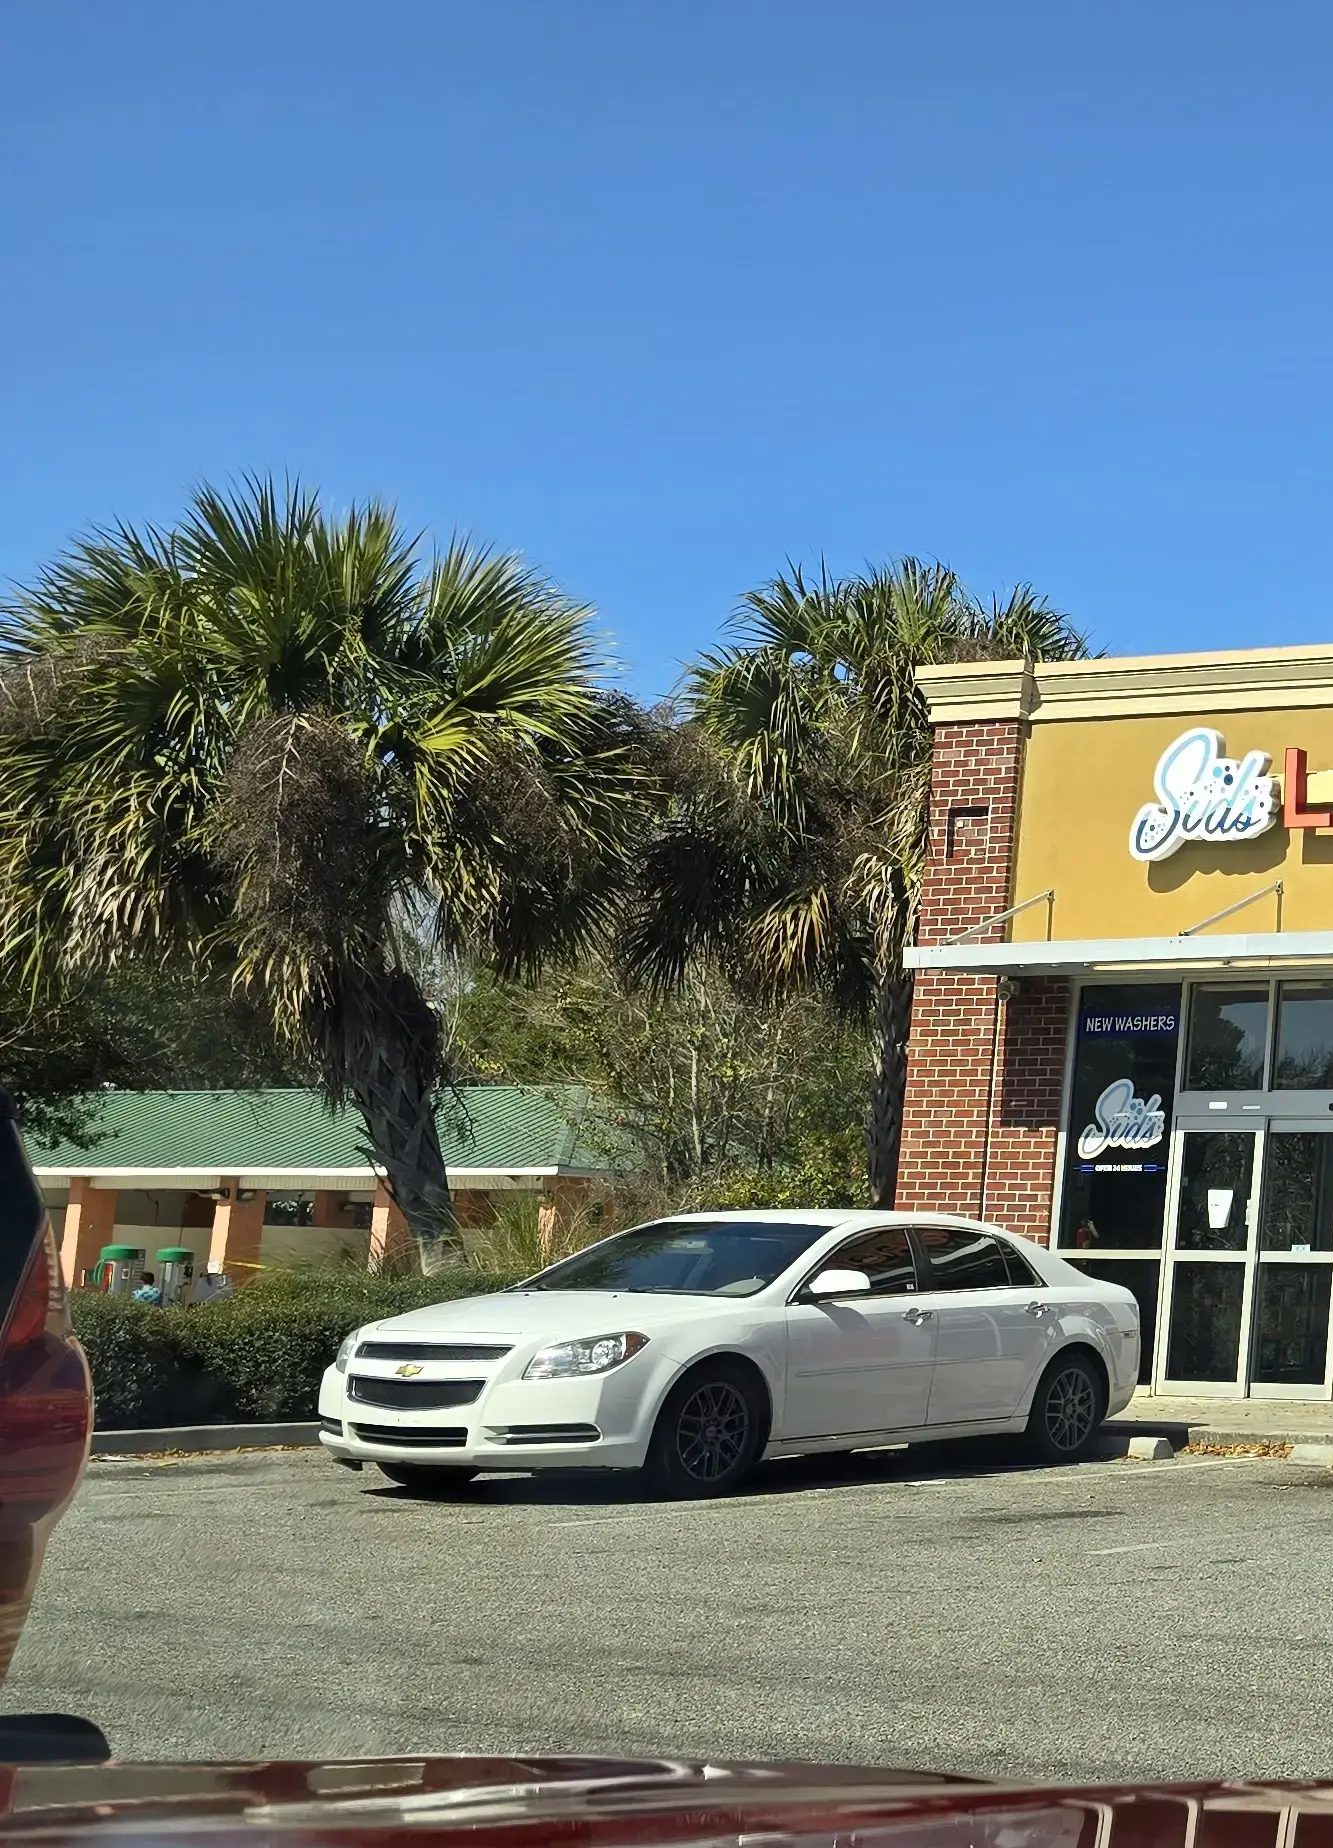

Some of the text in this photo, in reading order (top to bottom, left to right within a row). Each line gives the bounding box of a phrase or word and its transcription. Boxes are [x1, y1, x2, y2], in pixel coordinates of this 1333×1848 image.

[1133, 731, 1266, 856] Suds
[1086, 1015, 1175, 1032] NEW WASHERS
[1080, 1081, 1161, 1156] Suds
